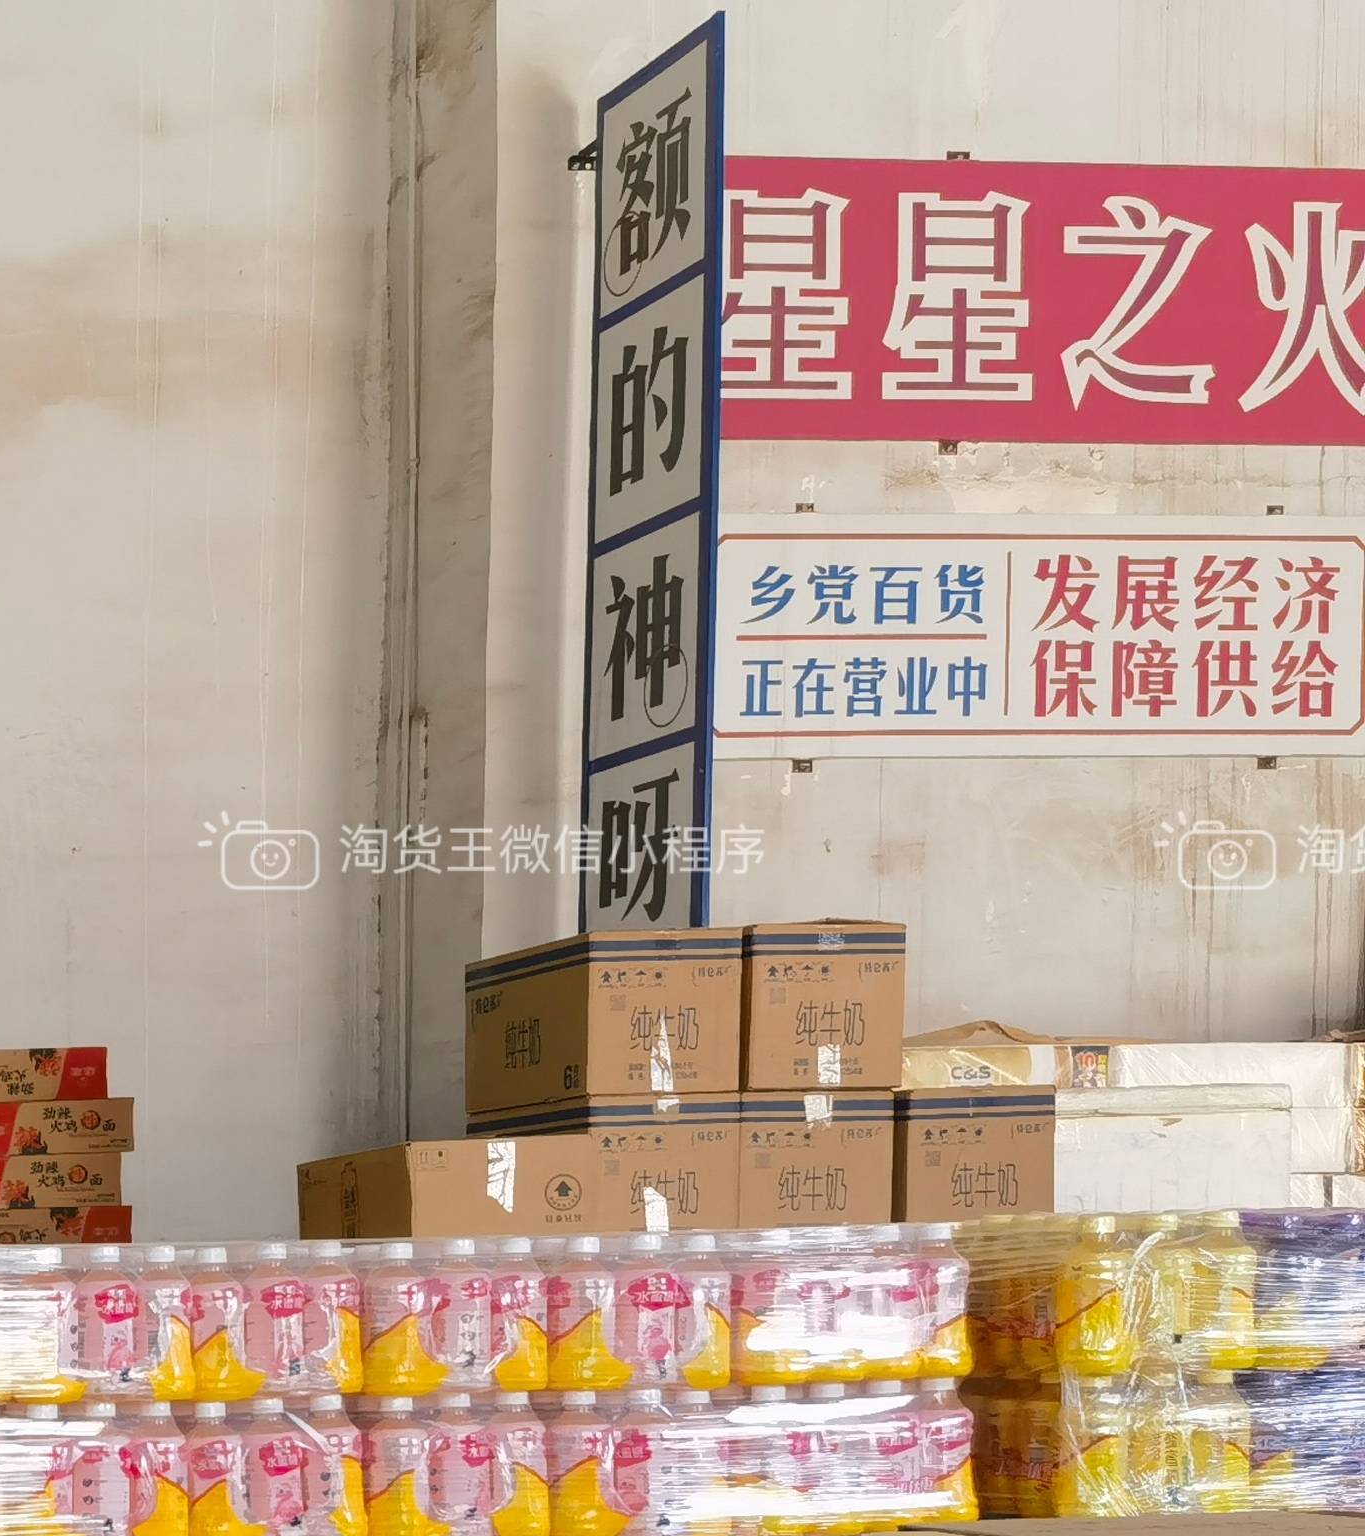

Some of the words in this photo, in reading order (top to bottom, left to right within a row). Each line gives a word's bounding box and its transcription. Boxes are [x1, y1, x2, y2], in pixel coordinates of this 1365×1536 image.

[722, 188, 1365, 416] 星星之火
[599, 87, 693, 924] 额的神呀
[739, 562, 987, 627] 乡党百货
[1033, 554, 1342, 634] 发展经济
[739, 656, 989, 719] 正在营业中
[1029, 639, 1340, 719] 保障供给
[795, 1000, 866, 1047] 纯牛奶
[777, 1164, 847, 1211] 纯牛奶
[951, 1161, 1020, 1208] 纯牛奶
